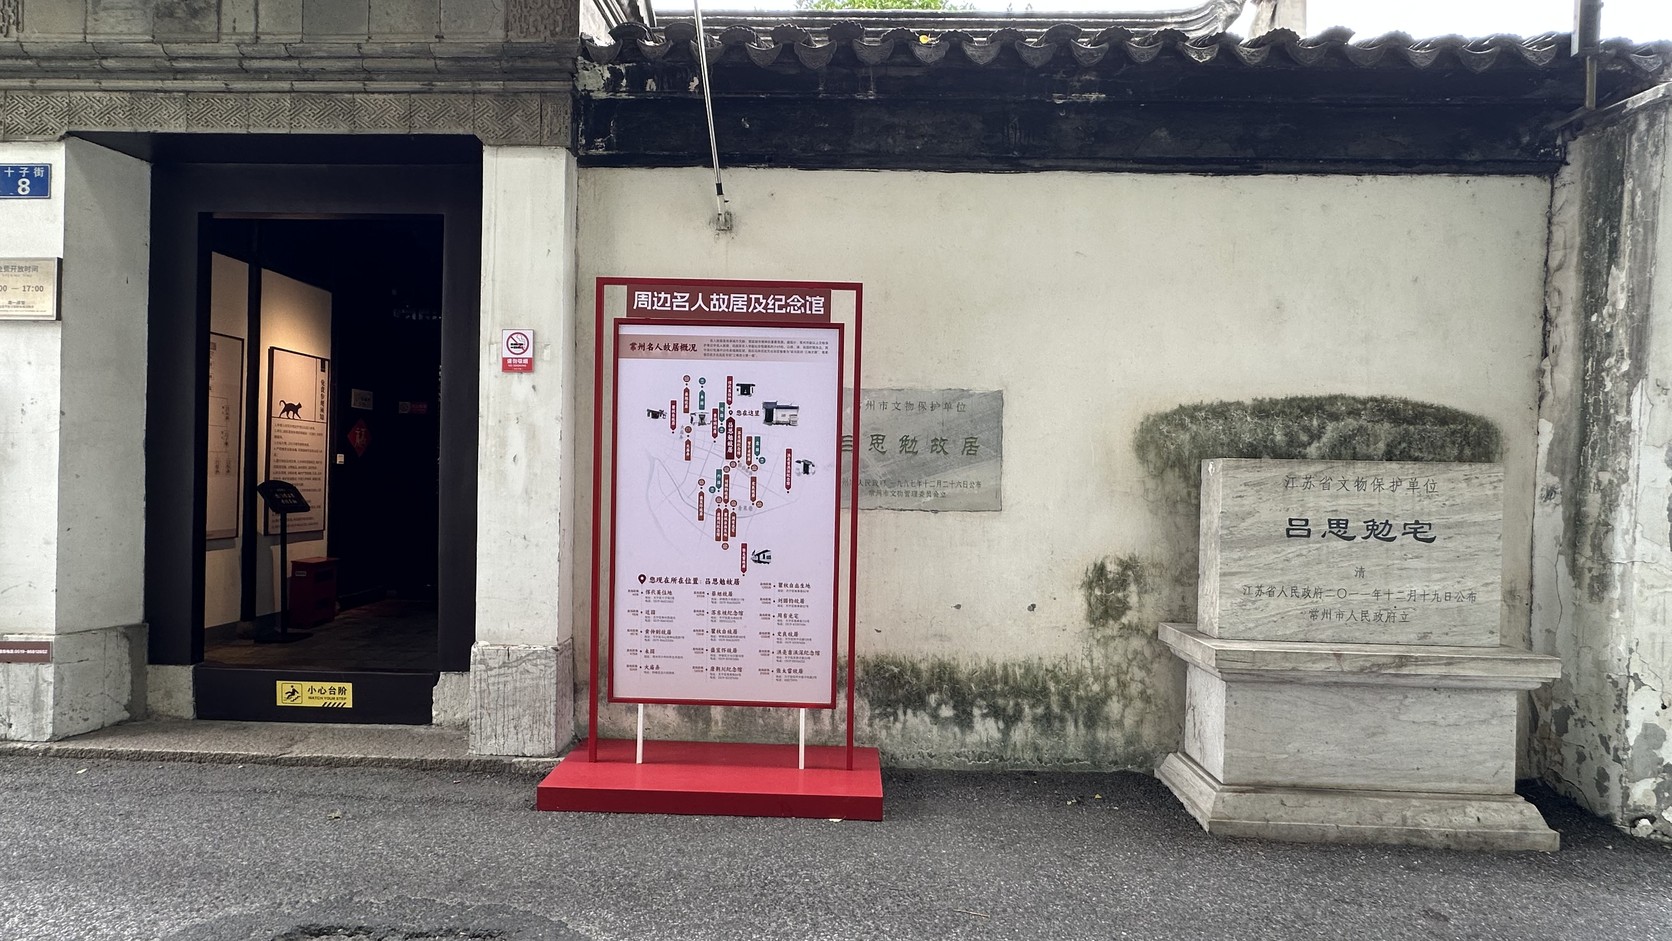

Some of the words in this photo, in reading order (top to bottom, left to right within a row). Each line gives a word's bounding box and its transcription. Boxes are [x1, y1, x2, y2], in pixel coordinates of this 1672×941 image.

[4, 166, 45, 178] 十子街
[17, 178, 31, 195] 8
[633, 290, 825, 315] 周边名人故居及纪念馆
[629, 342, 698, 353] 常州名人故居概况
[736, 409, 760, 417] 您在这里
[860, 400, 967, 413] 州市文物保护单位
[1284, 474, 1439, 494] 江苏省文物保护单位
[1285, 517, 1437, 544] 吕思勉宅
[1354, 566, 1366, 579] 清
[1308, 608, 1411, 624] 常州市人民政府立
[308, 685, 347, 695] 小心台阶
